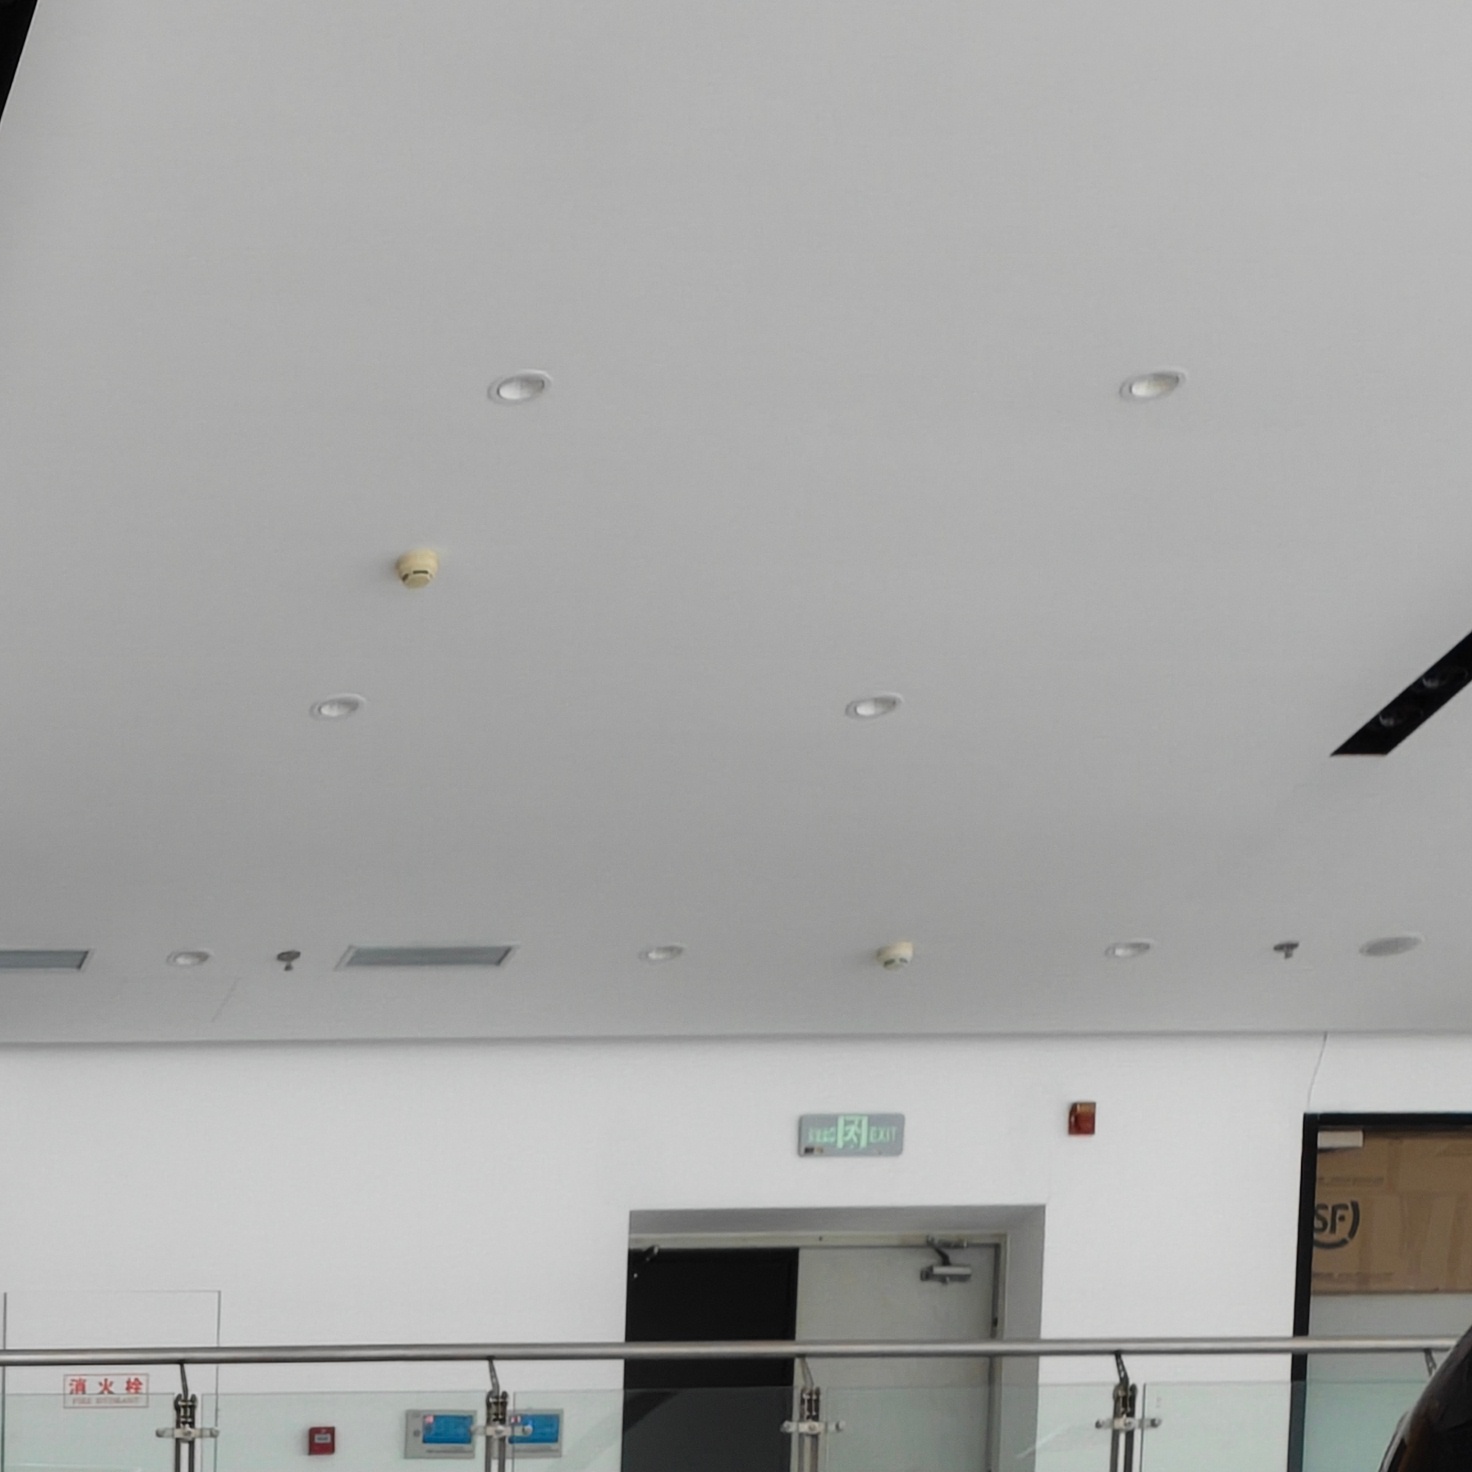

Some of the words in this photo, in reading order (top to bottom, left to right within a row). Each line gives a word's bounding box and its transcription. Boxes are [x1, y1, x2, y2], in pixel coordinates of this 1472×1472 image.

[869, 1125, 897, 1143] EXIT
[68, 1376, 143, 1396] 消火栓
